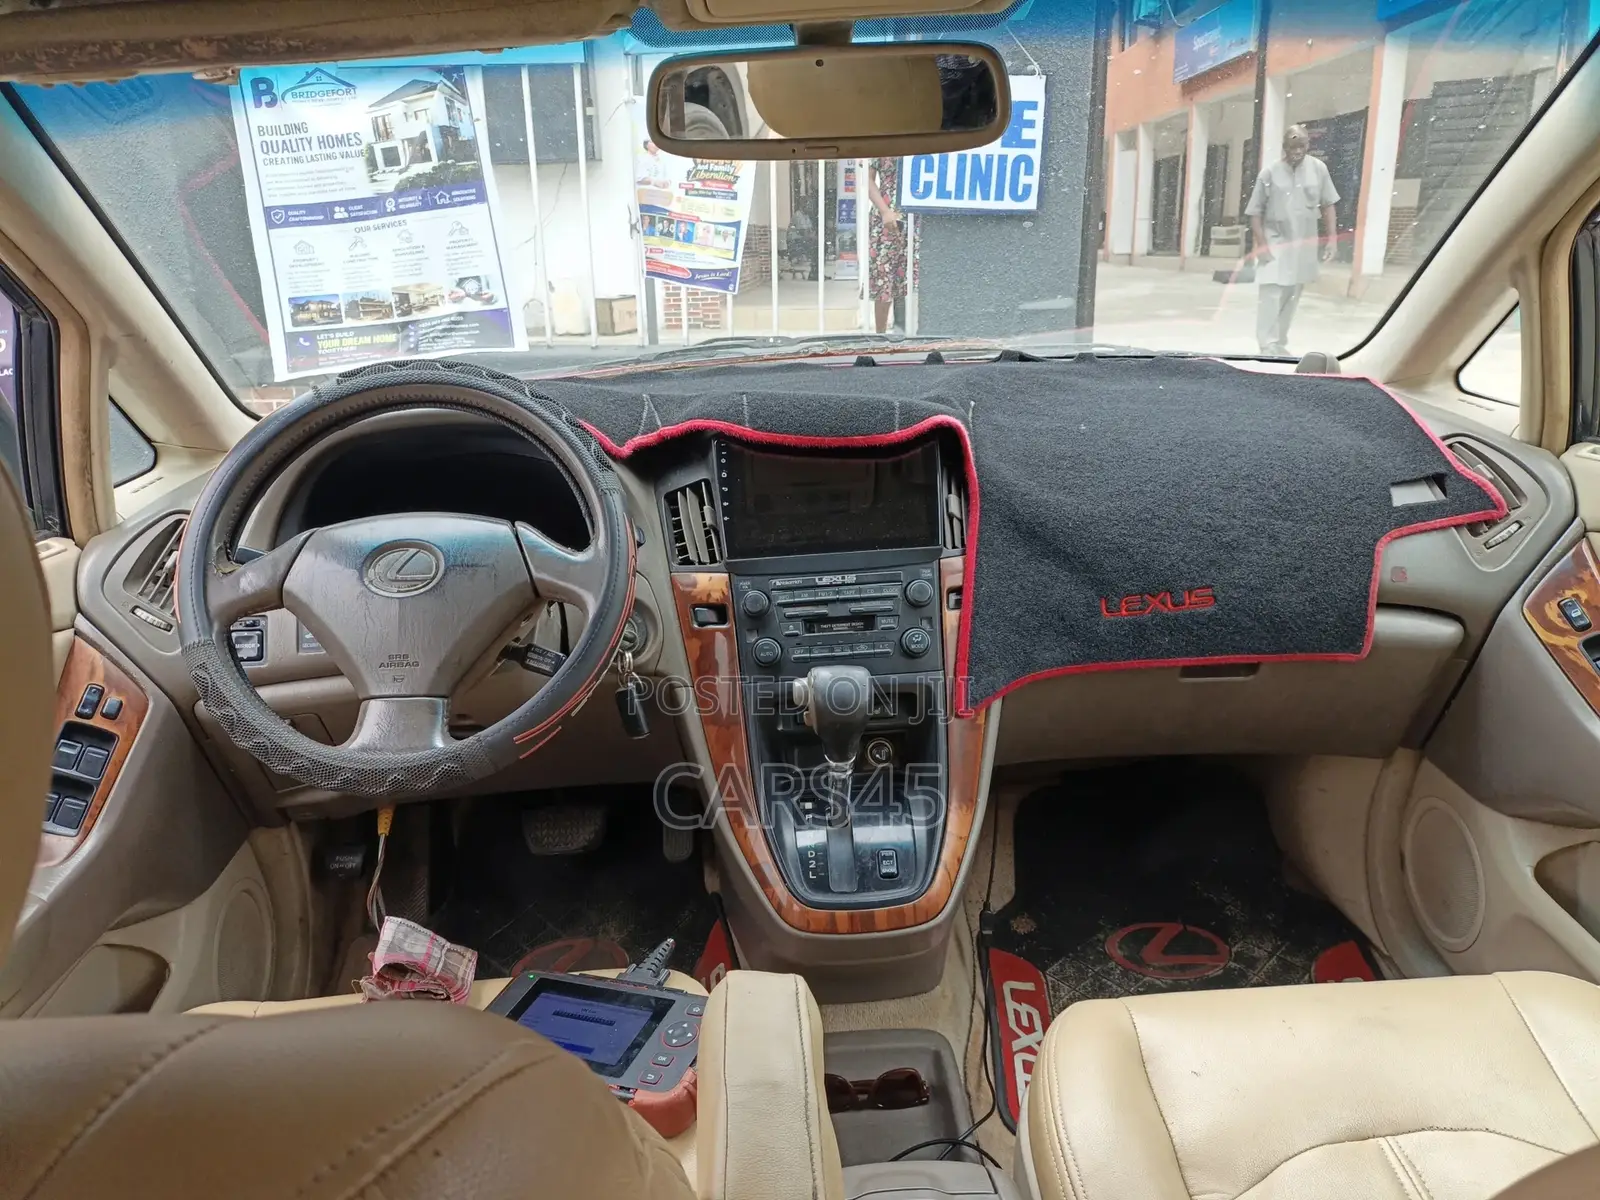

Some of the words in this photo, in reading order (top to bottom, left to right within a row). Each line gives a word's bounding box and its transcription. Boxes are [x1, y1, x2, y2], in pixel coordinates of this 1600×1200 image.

[291, 87, 357, 99] BRIDGEFORT
[257, 122, 309, 137] BUILDING
[261, 136, 312, 156] QUALITY
[317, 132, 363, 150] HOMES
[263, 156, 304, 167] CREATING
[306, 152, 337, 163] LASTING
[688, 168, 737, 182] Liberation
[910, 154, 1035, 203] CLINIC
[354, 226, 371, 234] OUR
[373, 220, 407, 231] SERVICES
[317, 339, 340, 349] YOUR
[342, 335, 371, 346] DREAM
[373, 333, 397, 344] HOME
[816, 574, 857, 583] LEXUS
[1100, 587, 1215, 618] LEXUS
[379, 661, 420, 669] AIRBAG
[808, 860, 816, 868] 2
[809, 871, 817, 879] L
[1003, 980, 1044, 1107] LEXU
